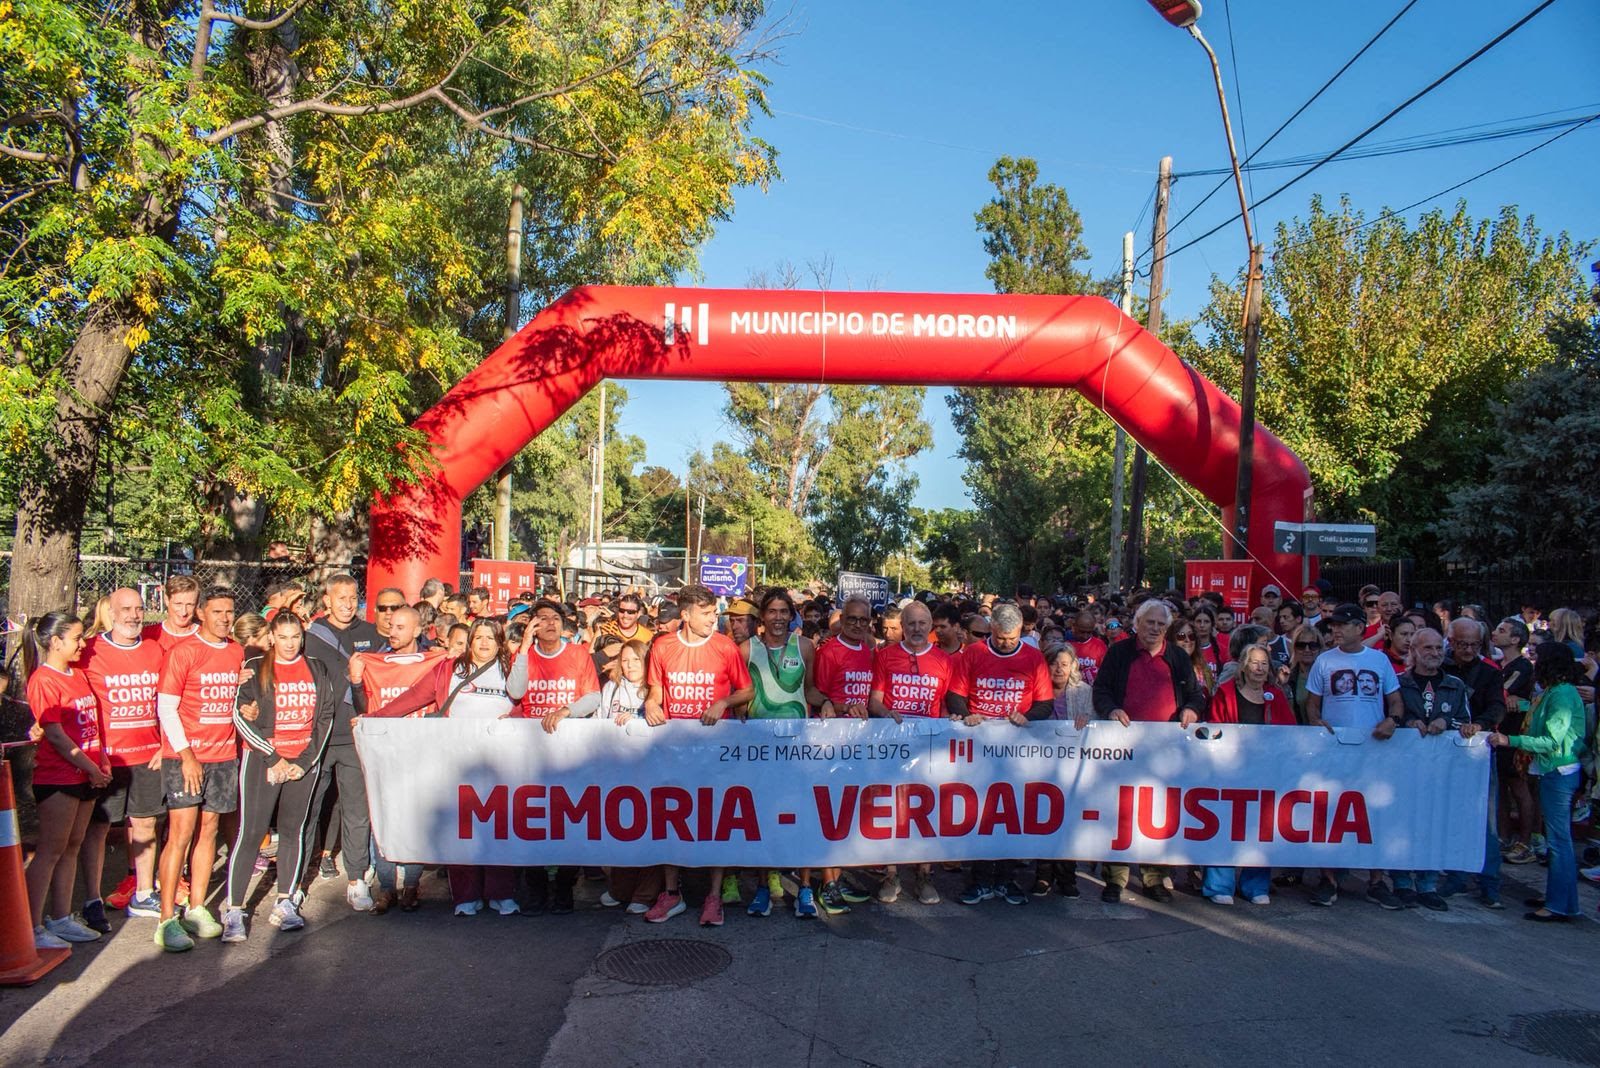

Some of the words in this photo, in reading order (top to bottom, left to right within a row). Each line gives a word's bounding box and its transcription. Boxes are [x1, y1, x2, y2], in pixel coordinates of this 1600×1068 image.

[730, 311, 864, 335] MUNICIPIO
[872, 312, 905, 335] DE
[913, 313, 1016, 338] MORON
[1340, 536, 1368, 544] Lacarra
[702, 574, 733, 582] autismo
[841, 577, 879, 590] hablemos
[104, 670, 159, 688] MORÓN
[667, 669, 716, 685] MORÓN
[844, 669, 874, 683] MORÓ
[891, 673, 939, 688] MORÓN
[273, 680, 317, 693] ORÓN
[527, 676, 576, 691] MORÓN
[976, 677, 1026, 690] MORÓN
[528, 691, 576, 705] CORRE
[669, 685, 715, 701] CORRE
[891, 686, 937, 701] CORRE
[976, 689, 1024, 703] CORRE
[201, 702, 229, 713] 2026
[275, 693, 317, 708] ORRE
[891, 700, 918, 711] 2026
[976, 701, 1003, 713] 2026
[110, 704, 144, 717] 2026
[276, 709, 299, 721] 026
[669, 702, 694, 714] 2026
[718, 743, 742, 762] 24
[747, 743, 770, 762] DE
[775, 743, 836, 762] MARZO
[841, 743, 863, 761] DE
[866, 742, 911, 761] 1976
[982, 744, 1052, 760] MUNICIPIO
[1057, 746, 1075, 760] DE
[1079, 747, 1134, 761] MORON
[458, 784, 762, 842] MEMORIA
[812, 781, 1065, 842] VERDAD
[1111, 785, 1373, 851] JUSTICIA
